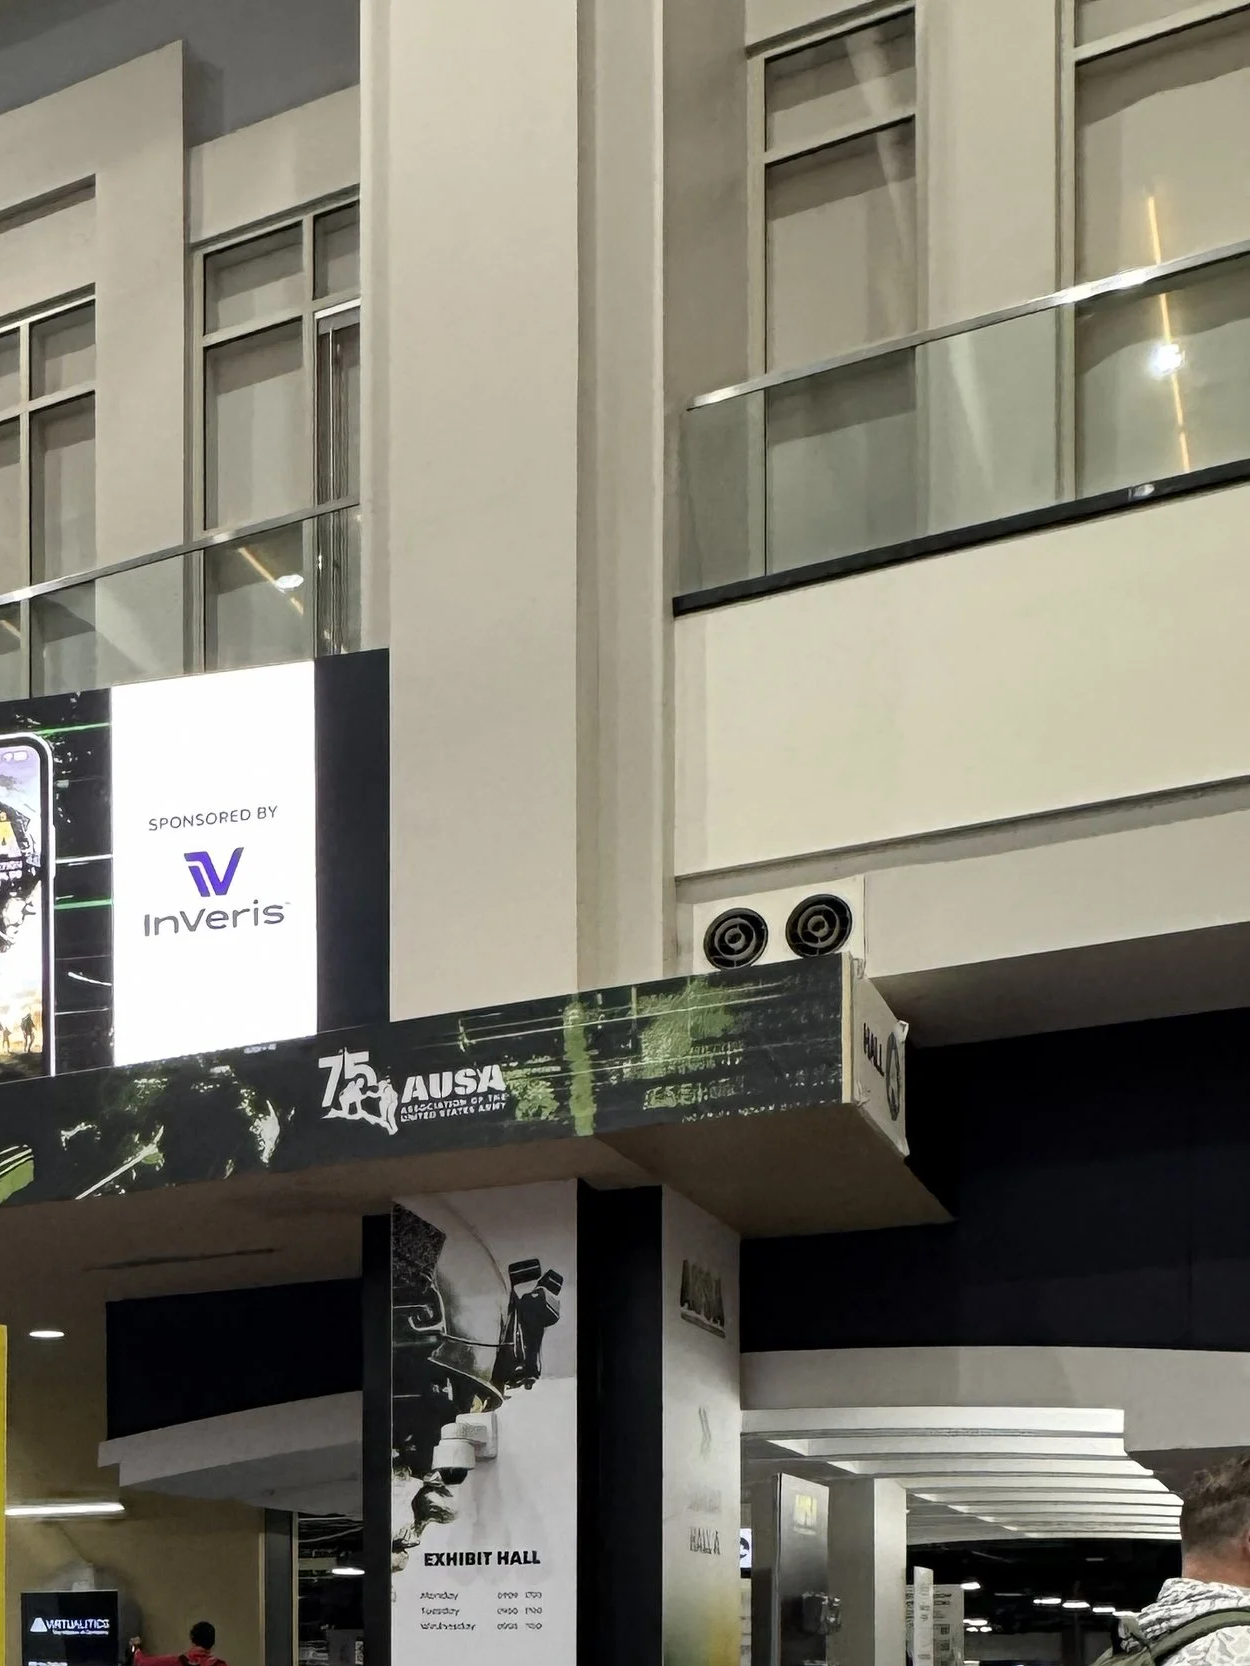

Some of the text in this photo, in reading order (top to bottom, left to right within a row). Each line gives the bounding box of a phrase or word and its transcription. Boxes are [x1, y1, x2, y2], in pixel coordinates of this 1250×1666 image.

[148, 804, 278, 831] SPONSORED BY
[401, 1063, 507, 1104] AUSA
[424, 1550, 541, 1567] EXHIBIT HALL
[419, 1591, 458, 1601] Monday
[421, 1607, 460, 1617] Tuesday
